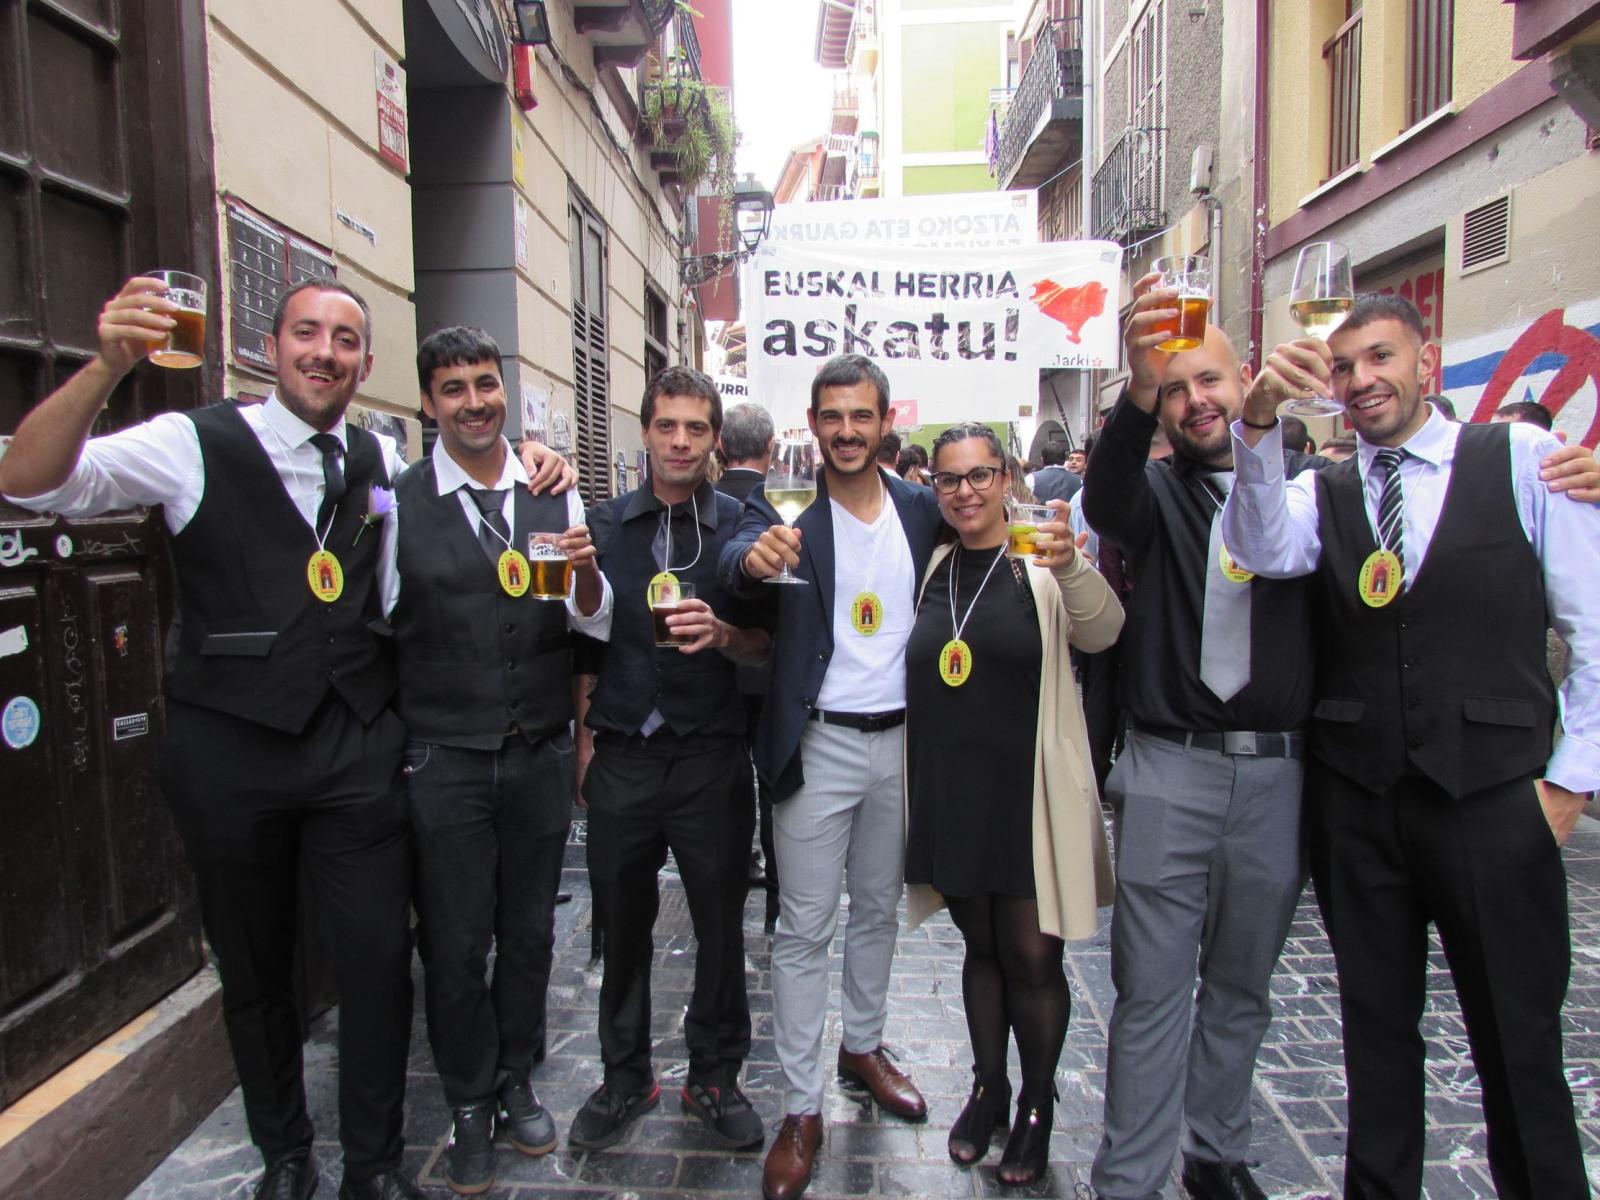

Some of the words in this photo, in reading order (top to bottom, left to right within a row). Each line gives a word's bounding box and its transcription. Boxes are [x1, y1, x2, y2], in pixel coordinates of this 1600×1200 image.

[764, 270, 885, 298] EUSKAL
[895, 271, 1019, 300] HERRIA
[763, 303, 1019, 361] askatu!
[1052, 353, 1089, 366] Jarki
